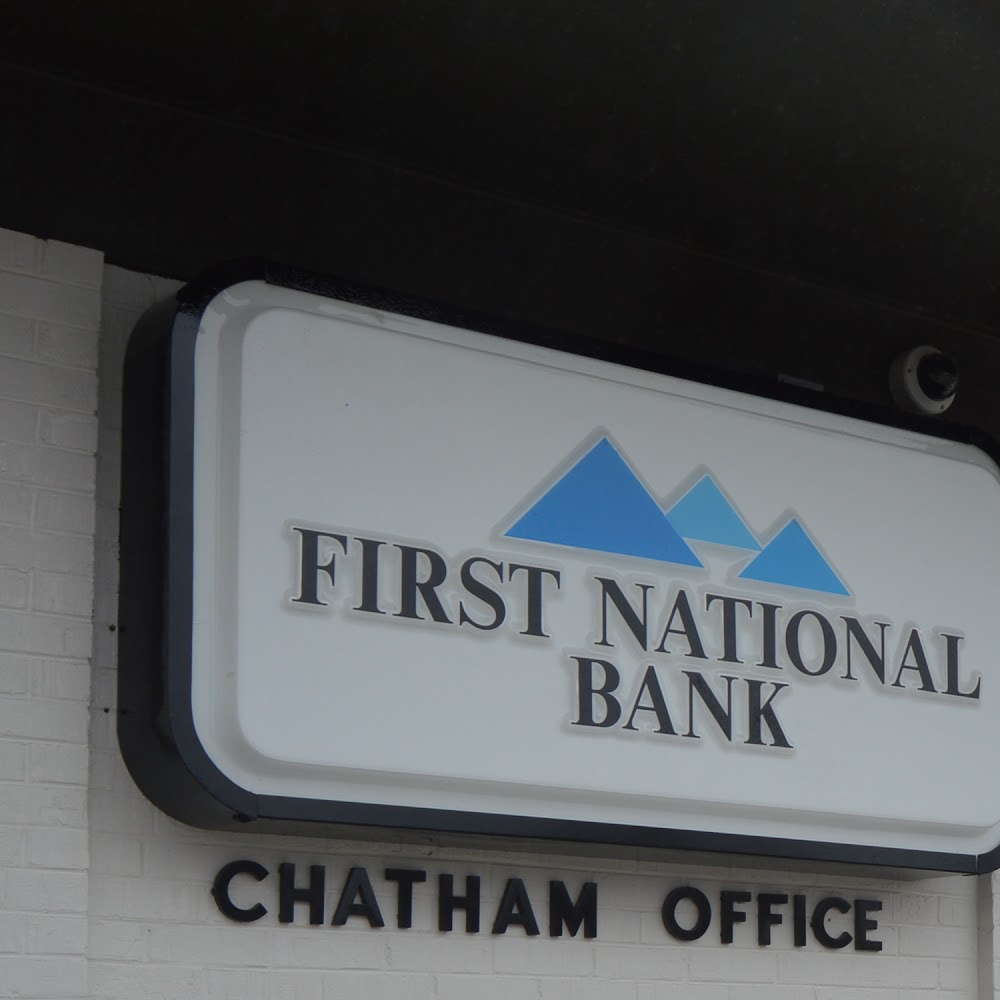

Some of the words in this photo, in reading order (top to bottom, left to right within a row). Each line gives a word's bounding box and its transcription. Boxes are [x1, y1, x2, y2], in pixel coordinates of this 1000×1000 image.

[291, 526, 562, 639] FIRST
[593, 574, 982, 702] NATIONAL
[569, 655, 794, 750] BANK
[211, 860, 598, 939] CHATHAM
[661, 886, 883, 952] OFFICE
